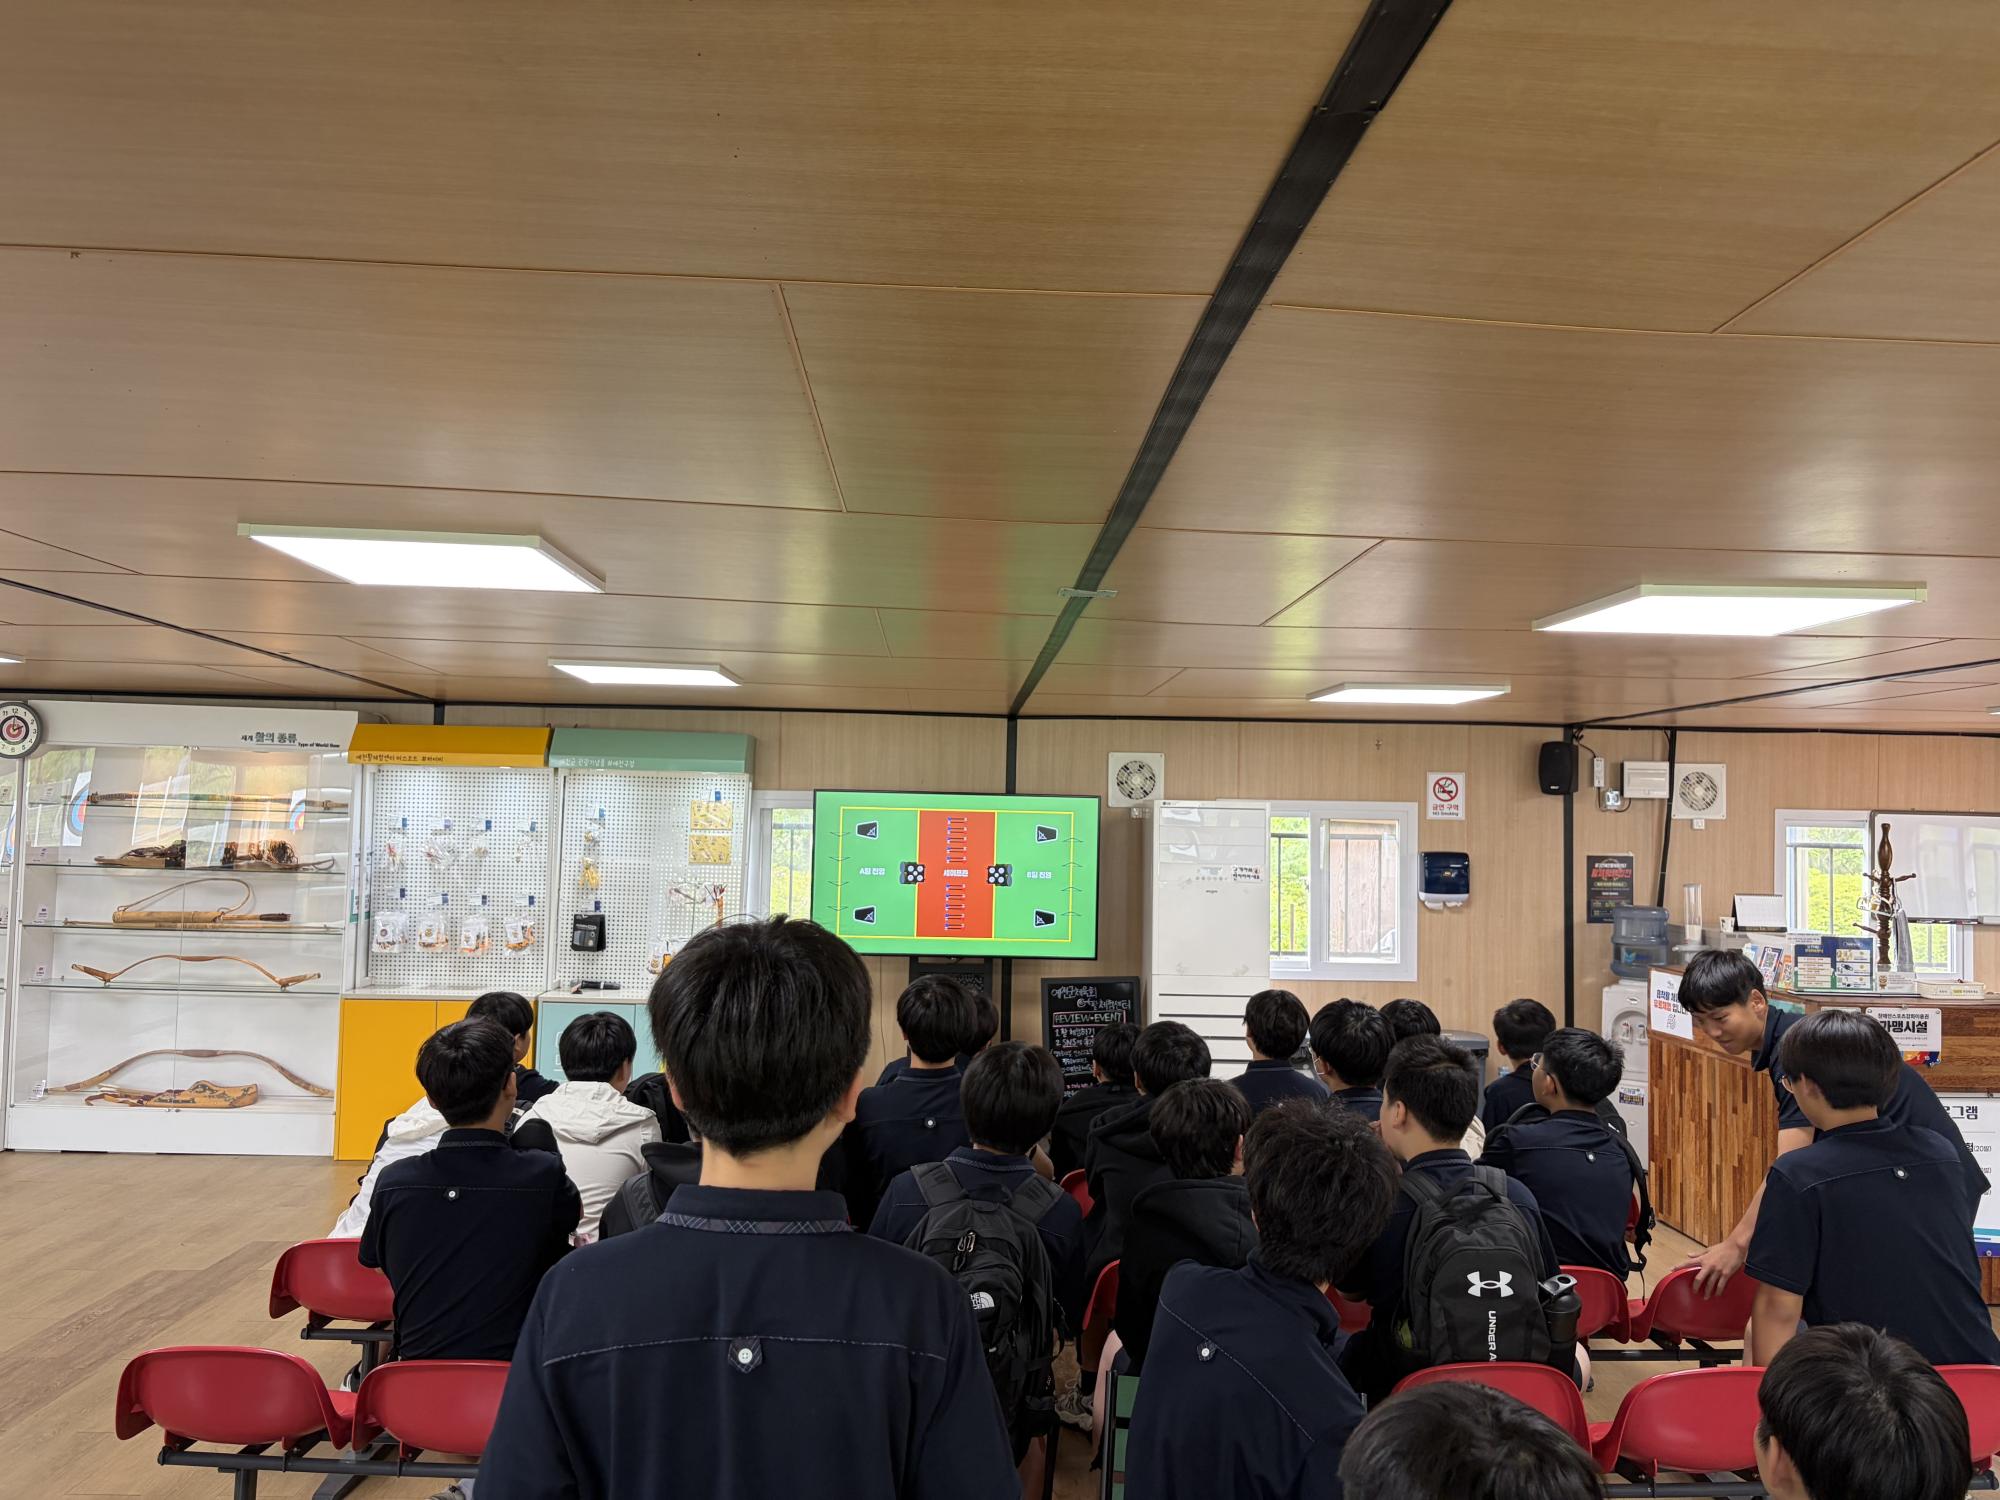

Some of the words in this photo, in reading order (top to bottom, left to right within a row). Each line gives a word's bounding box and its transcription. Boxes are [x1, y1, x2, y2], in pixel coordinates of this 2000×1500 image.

[277, 732, 297, 744] 종류
[1432, 803, 1445, 811] 금연
[1446, 803, 1459, 811] 구역
[1055, 1013, 1090, 1024] REVIEW
[1094, 1011, 1123, 1023] EVENT
[1880, 1020, 1928, 1034] 가맹시설
[1488, 1310, 1497, 1351] UNDER
